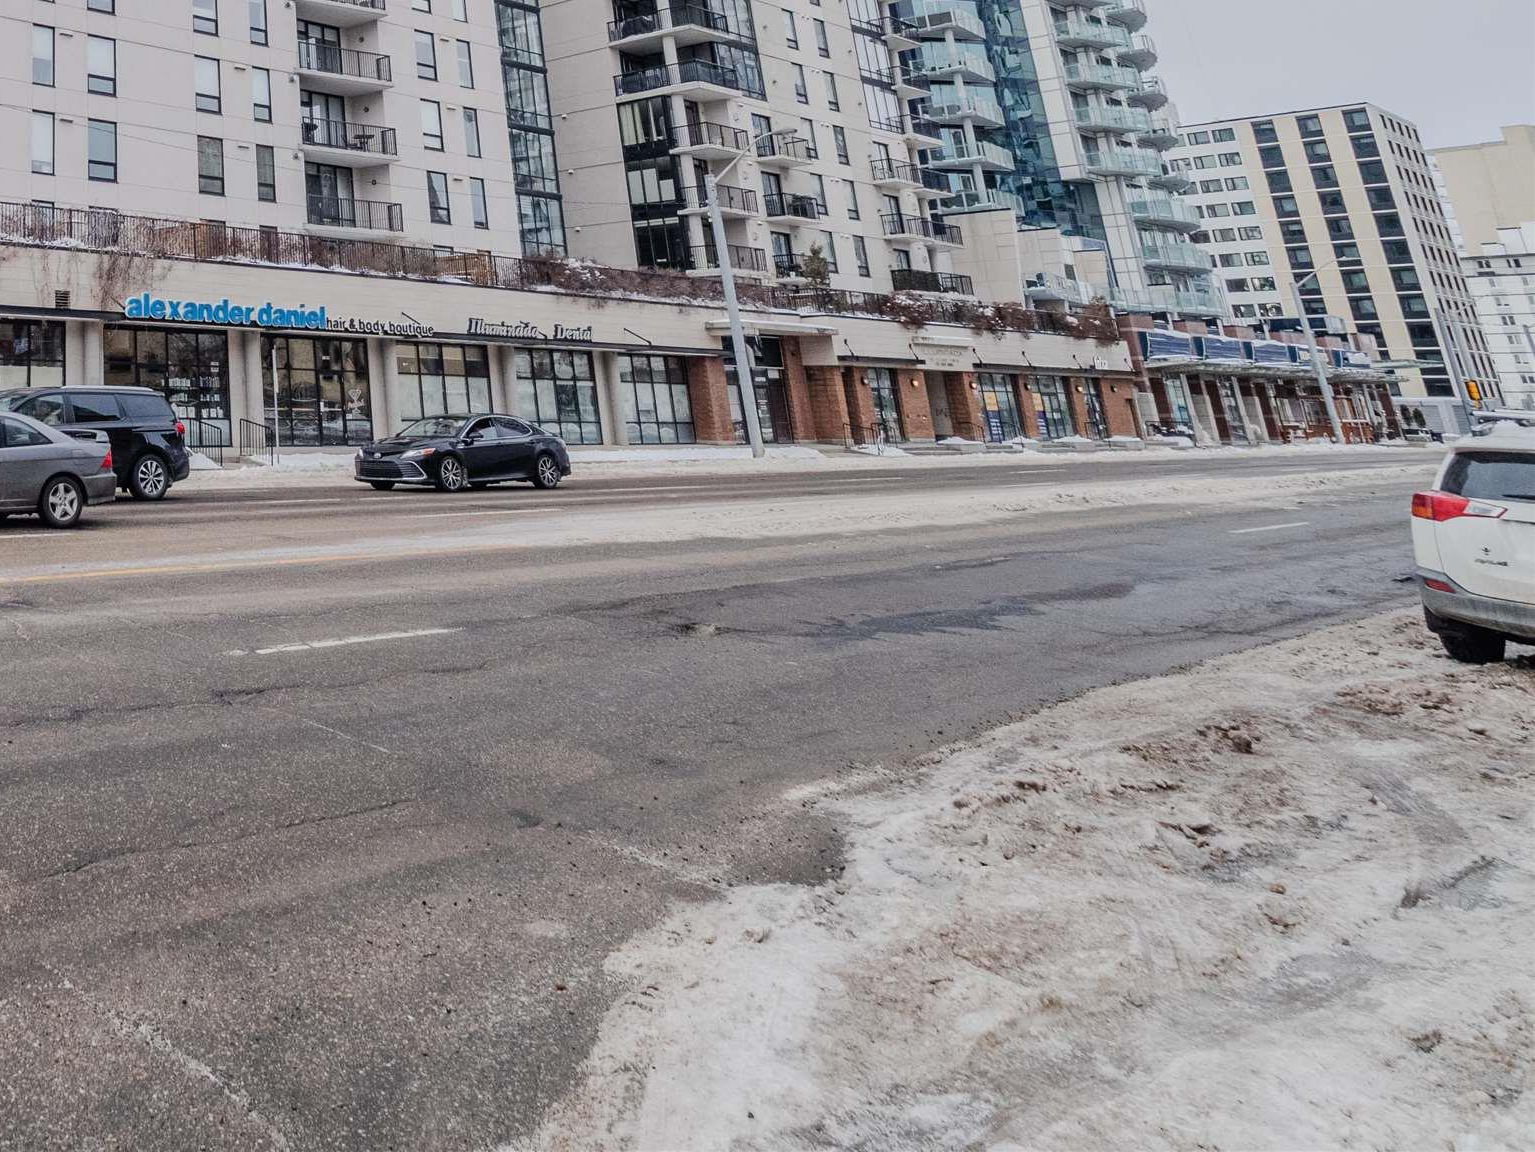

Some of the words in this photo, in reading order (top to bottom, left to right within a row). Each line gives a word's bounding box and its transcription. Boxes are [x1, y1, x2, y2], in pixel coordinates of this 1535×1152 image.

[124, 291, 255, 325] alexander
[256, 301, 327, 329] daniel
[326, 317, 346, 330] hair
[348, 318, 356, 330] &
[358, 319, 386, 335] body
[388, 321, 434, 338] boutique
[553, 323, 593, 342] Dental
